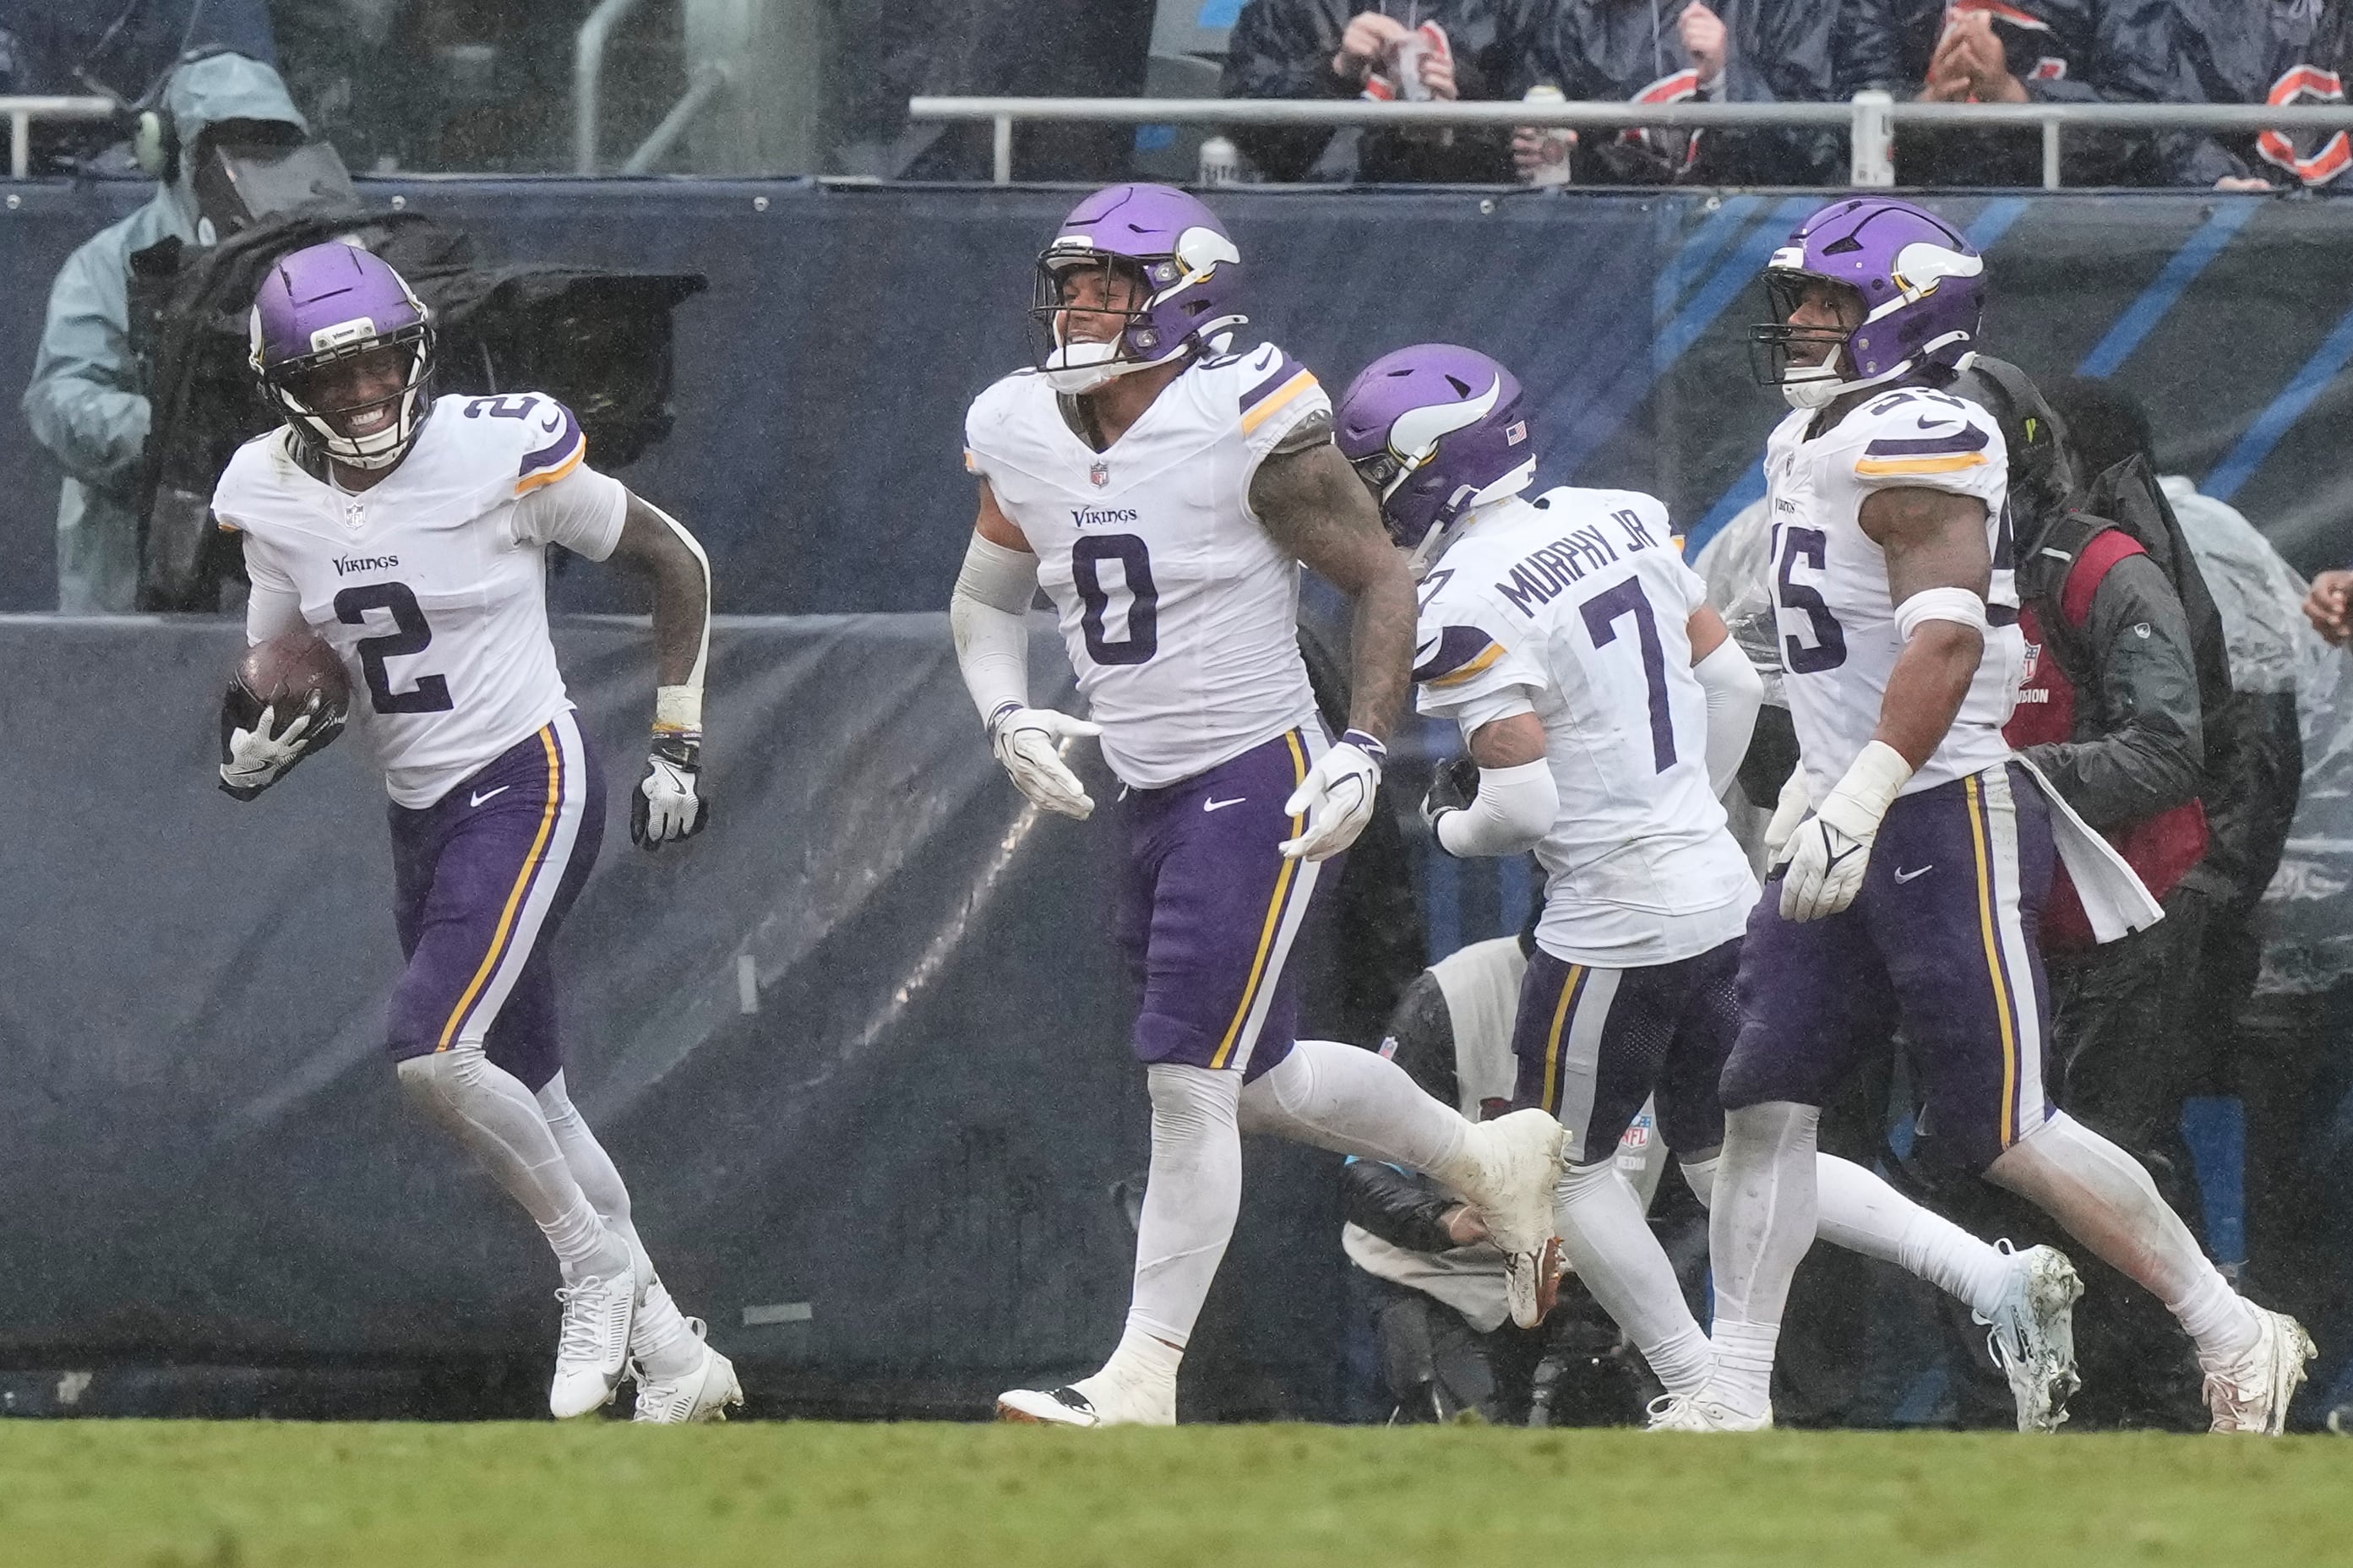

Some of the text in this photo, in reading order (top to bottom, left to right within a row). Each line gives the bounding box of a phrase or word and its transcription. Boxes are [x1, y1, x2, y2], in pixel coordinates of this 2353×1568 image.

[463, 396, 540, 420] 2
[1072, 534, 1158, 665] 0
[1495, 509, 1659, 619] MURPHY JR
[1768, 522, 1847, 674] 5
[334, 581, 454, 714] 2
[1579, 574, 1677, 775] 7
